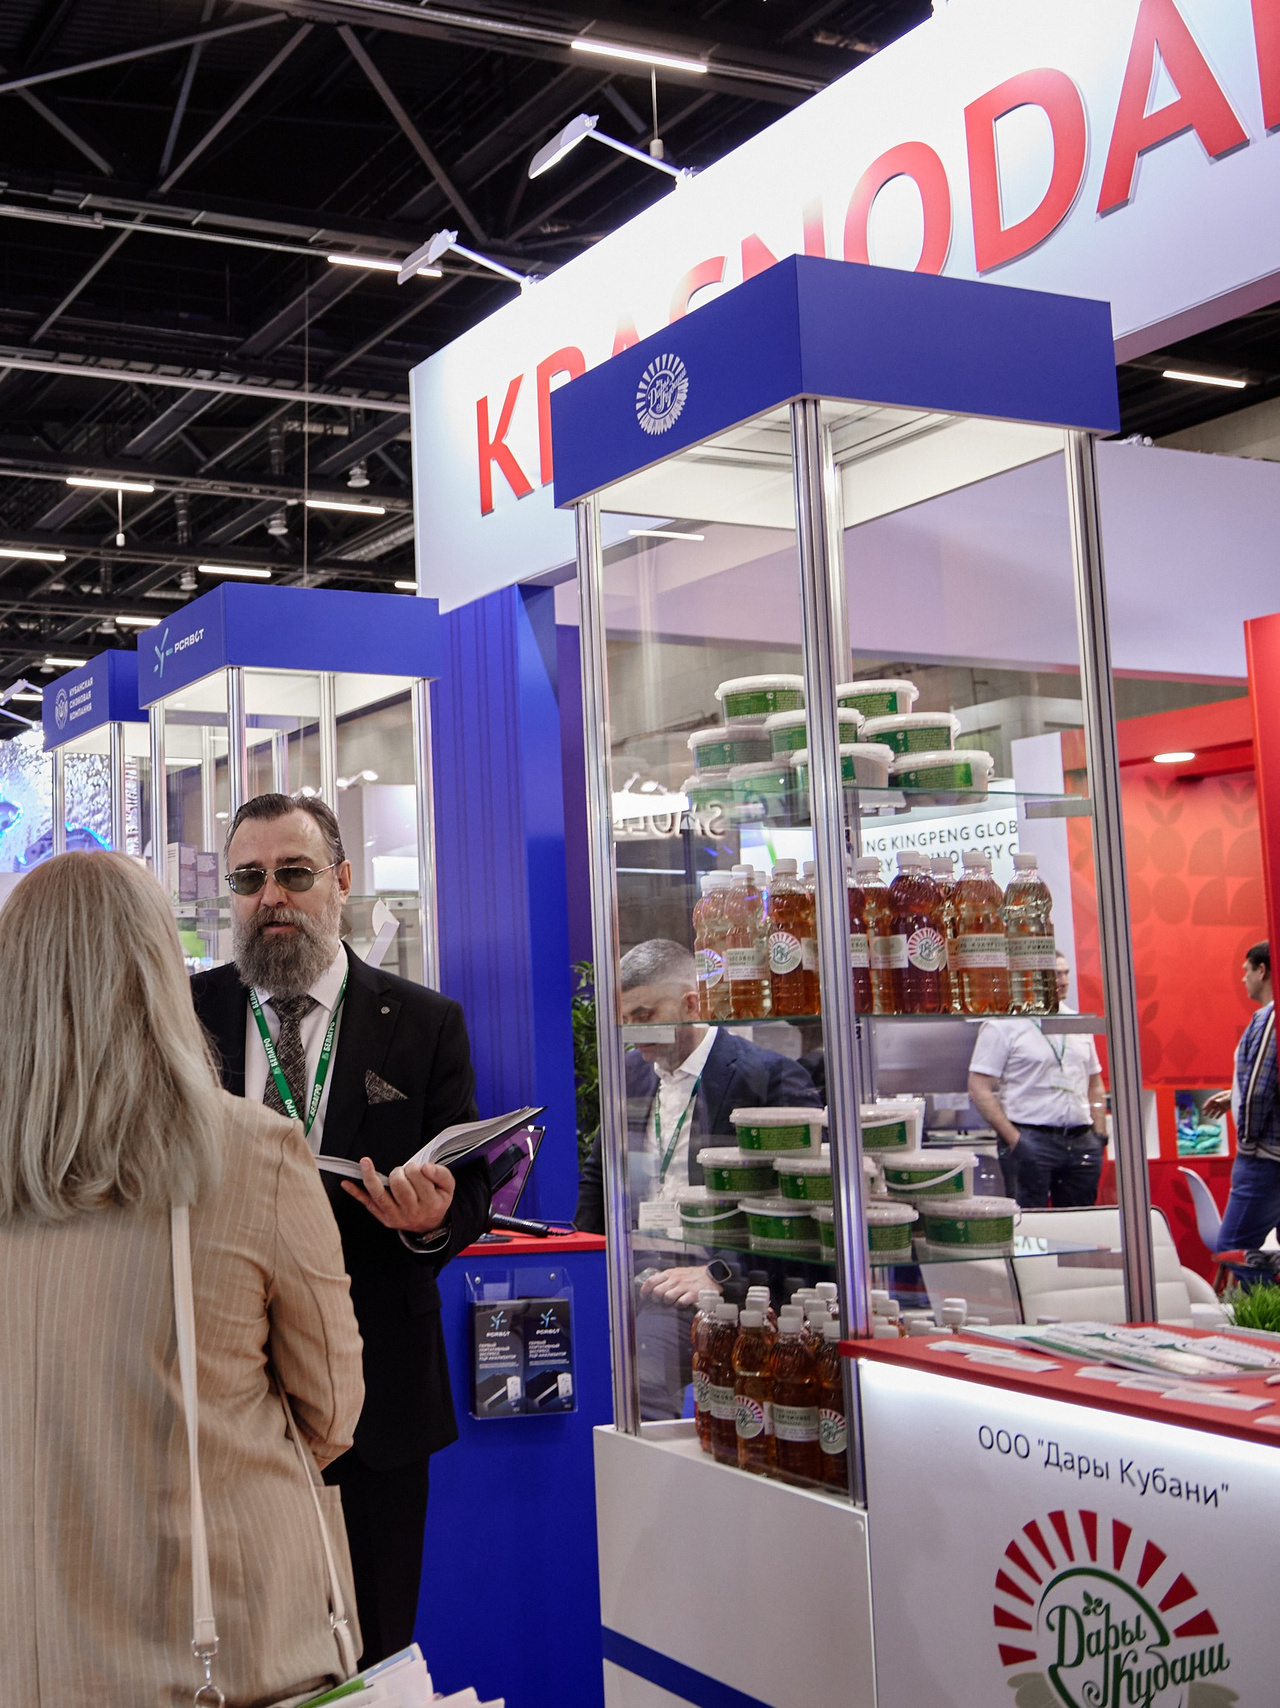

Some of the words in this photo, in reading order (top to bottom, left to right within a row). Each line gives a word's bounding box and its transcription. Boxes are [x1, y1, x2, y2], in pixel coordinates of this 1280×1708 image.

[174, 628, 204, 653] PCRBOT
[891, 826, 970, 849] KINGPENG
[324, 1022, 336, 1051] БЕЛАГРО
[264, 1037, 279, 1067] БЕЛАГРО
[979, 1425, 1030, 1459] ООО
[1037, 1439, 1109, 1479] "Дары
[1120, 1458, 1229, 1508] Кубани"
[1046, 1603, 1147, 1707] Дары
[1111, 1643, 1230, 1708] Кубани
